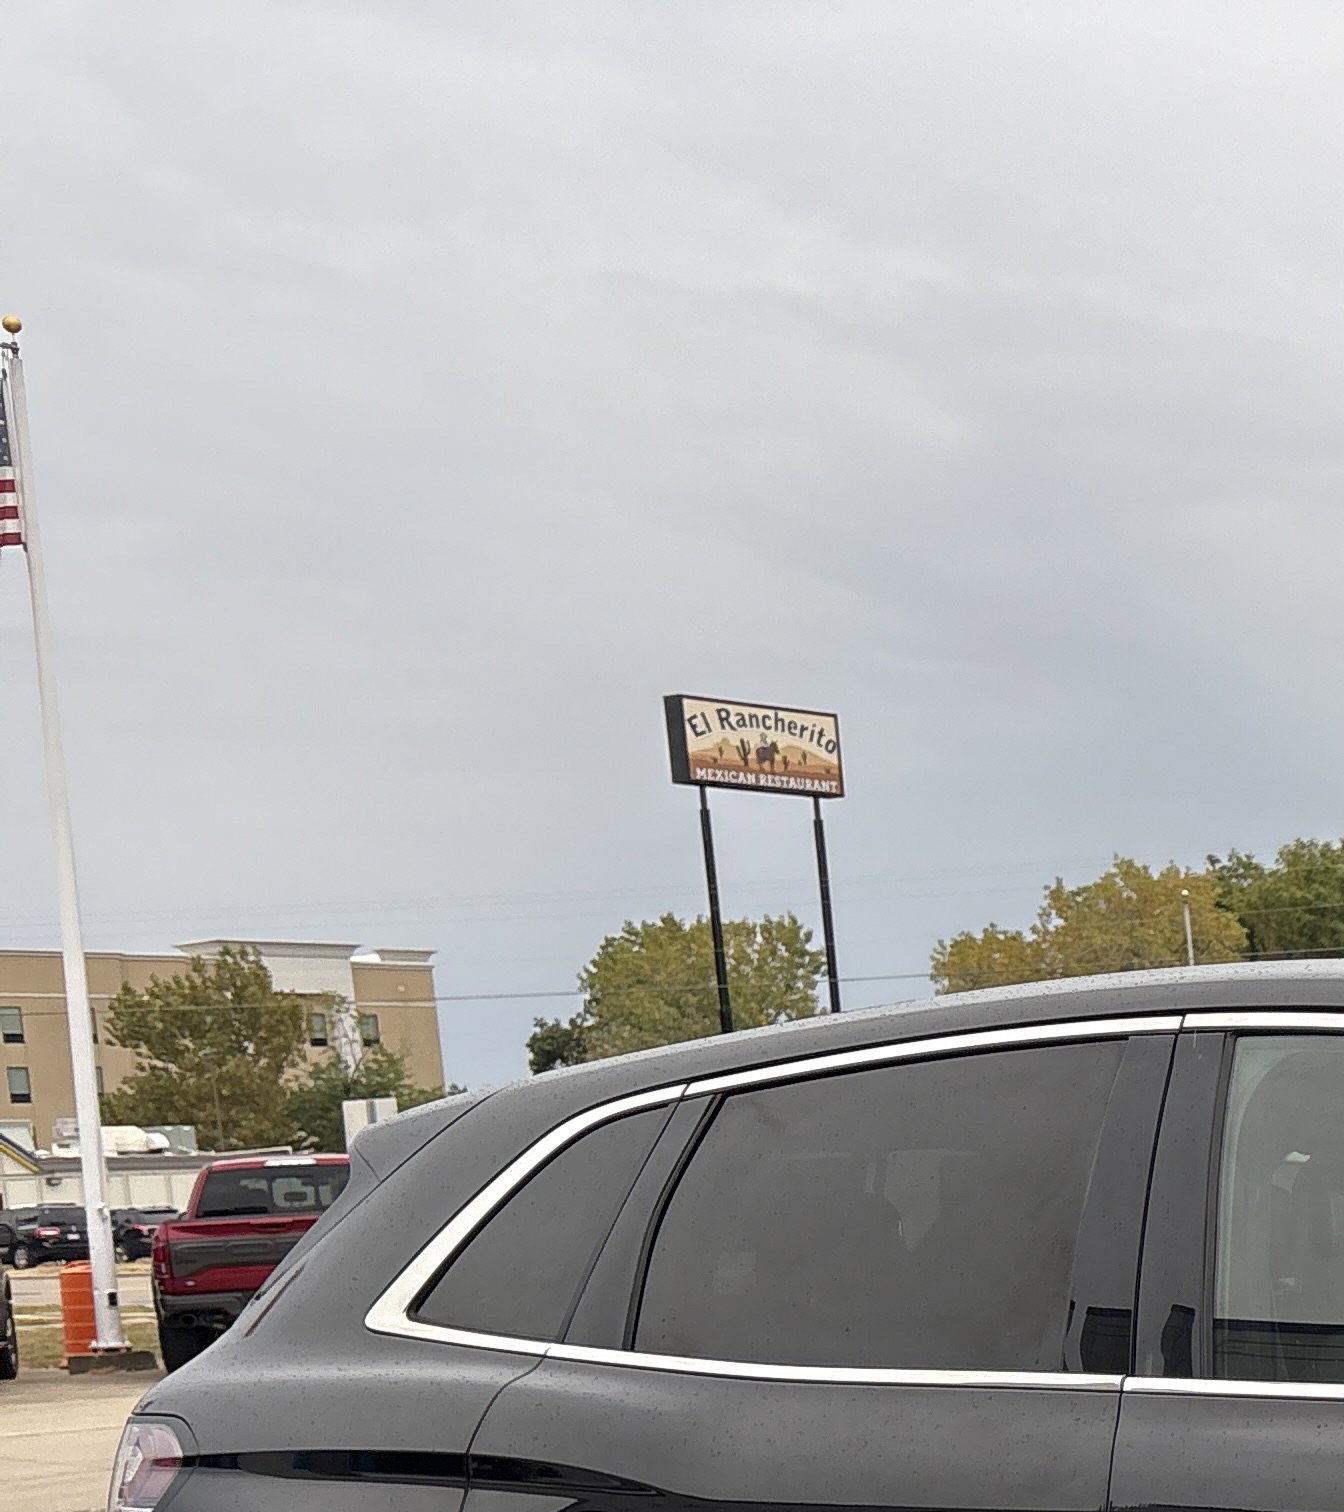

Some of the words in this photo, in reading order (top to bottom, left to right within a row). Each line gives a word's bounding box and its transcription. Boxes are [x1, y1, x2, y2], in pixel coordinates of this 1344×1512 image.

[687, 711, 712, 738] El
[716, 707, 838, 754] Rancherito
[695, 767, 756, 785] MEXICAN
[758, 773, 839, 794] RESTAURANT
